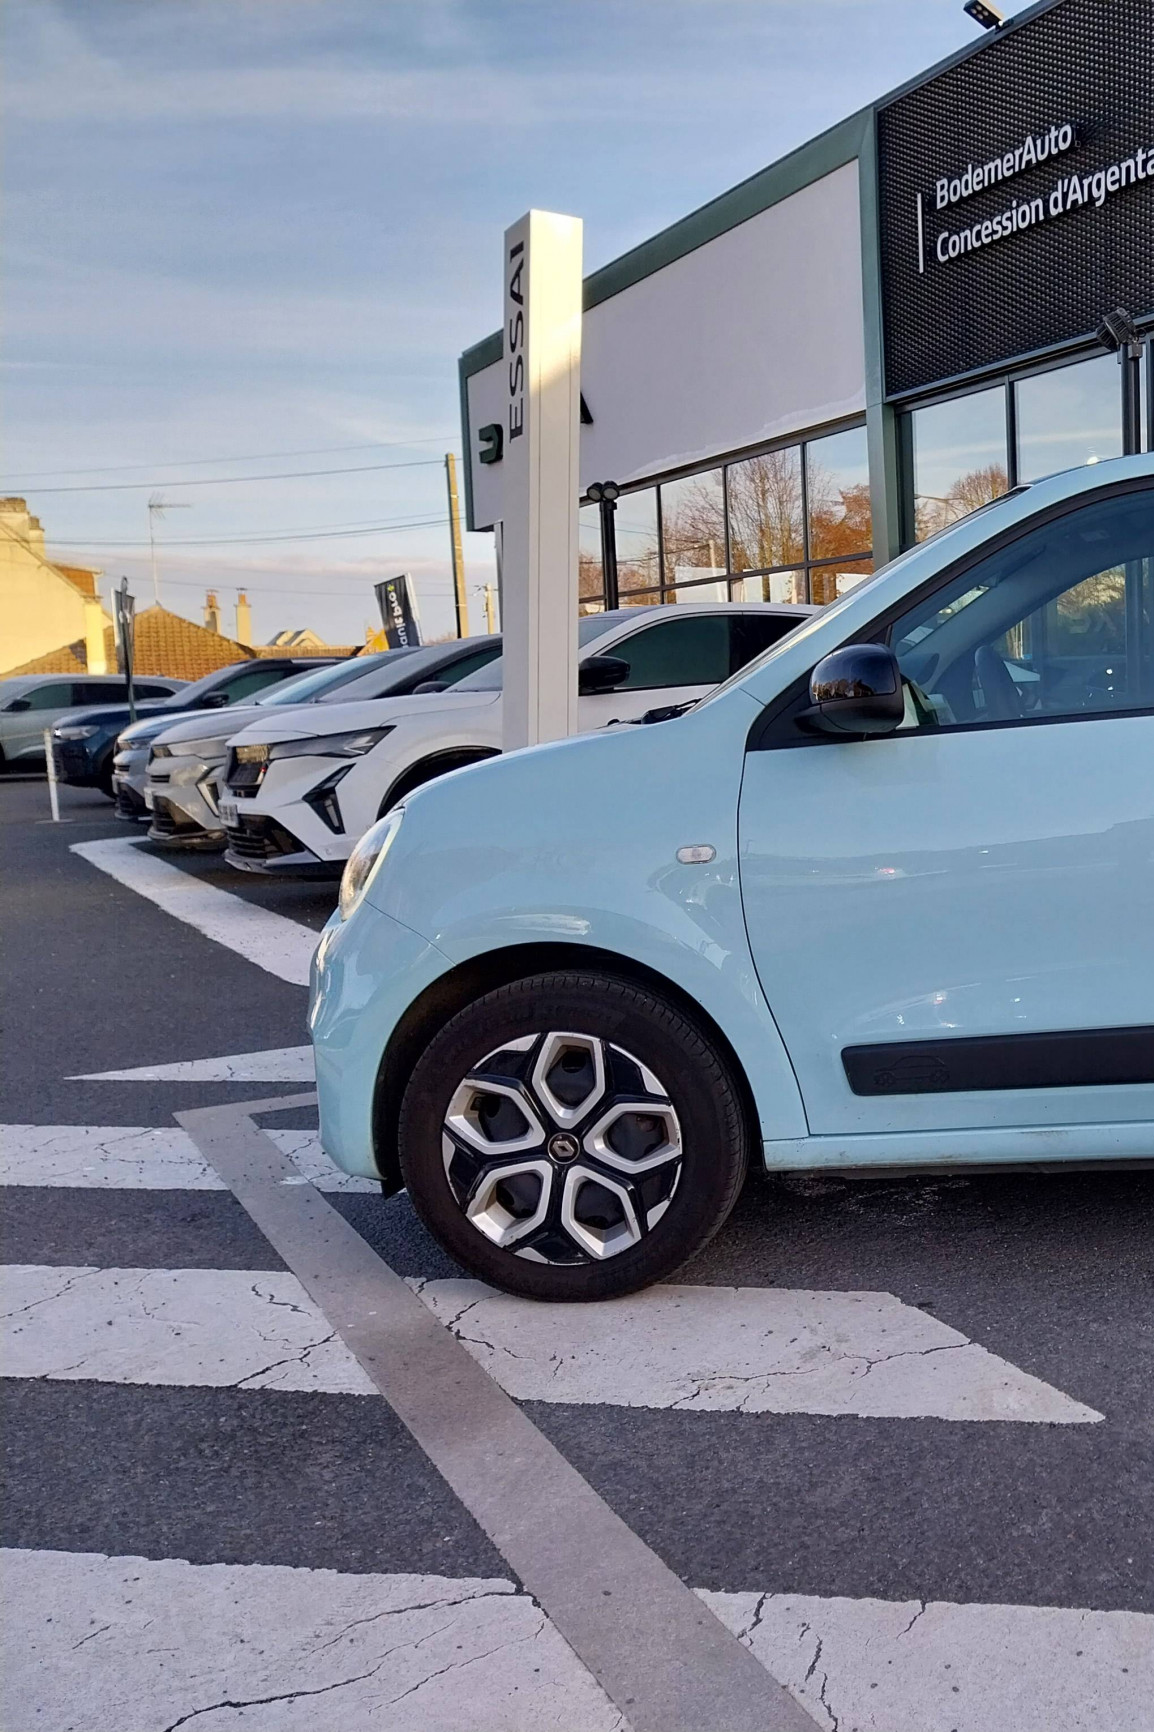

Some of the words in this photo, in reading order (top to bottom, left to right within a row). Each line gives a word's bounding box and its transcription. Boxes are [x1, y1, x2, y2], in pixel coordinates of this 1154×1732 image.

[936, 123, 1073, 209] BodemerAuto
[936, 197, 1045, 264] Concession
[509, 240, 525, 444] ESSAI
